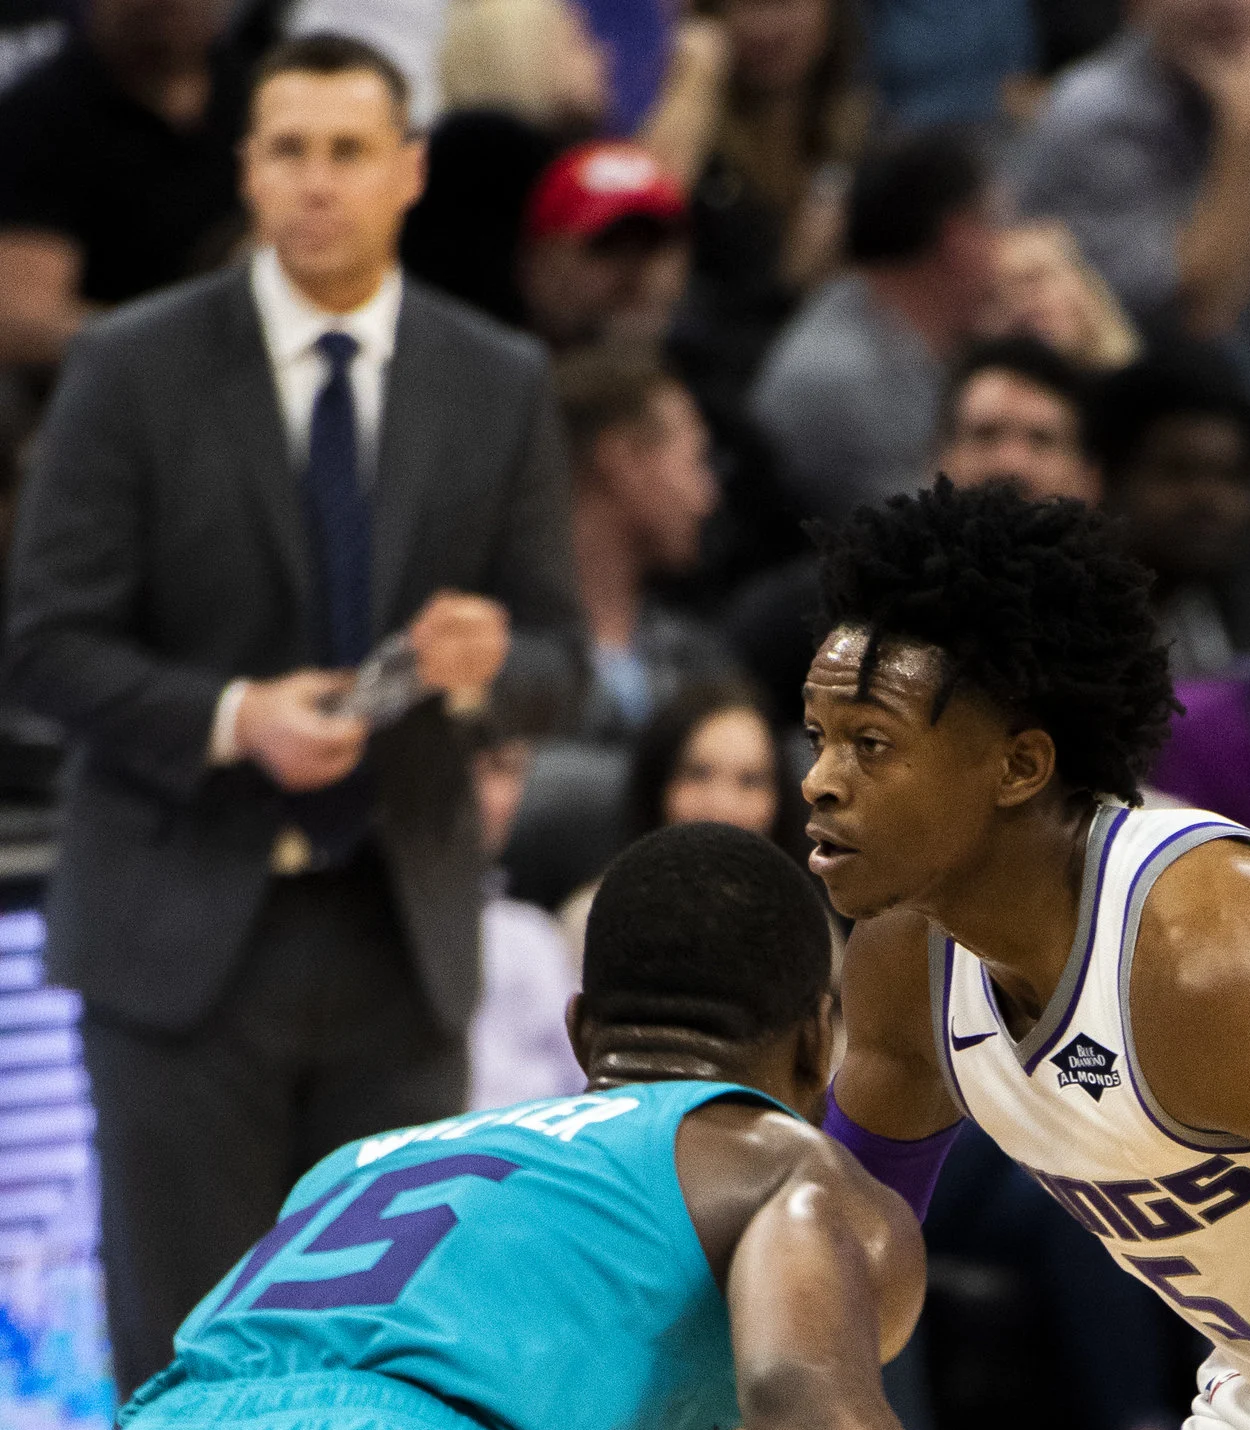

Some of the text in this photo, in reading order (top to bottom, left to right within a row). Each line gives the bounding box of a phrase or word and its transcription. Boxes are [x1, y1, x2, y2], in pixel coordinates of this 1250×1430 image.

[1076, 1044, 1095, 1058] BLUE
[1068, 1054, 1106, 1069] DIAMOND
[1060, 1070, 1120, 1086] ALMONDS
